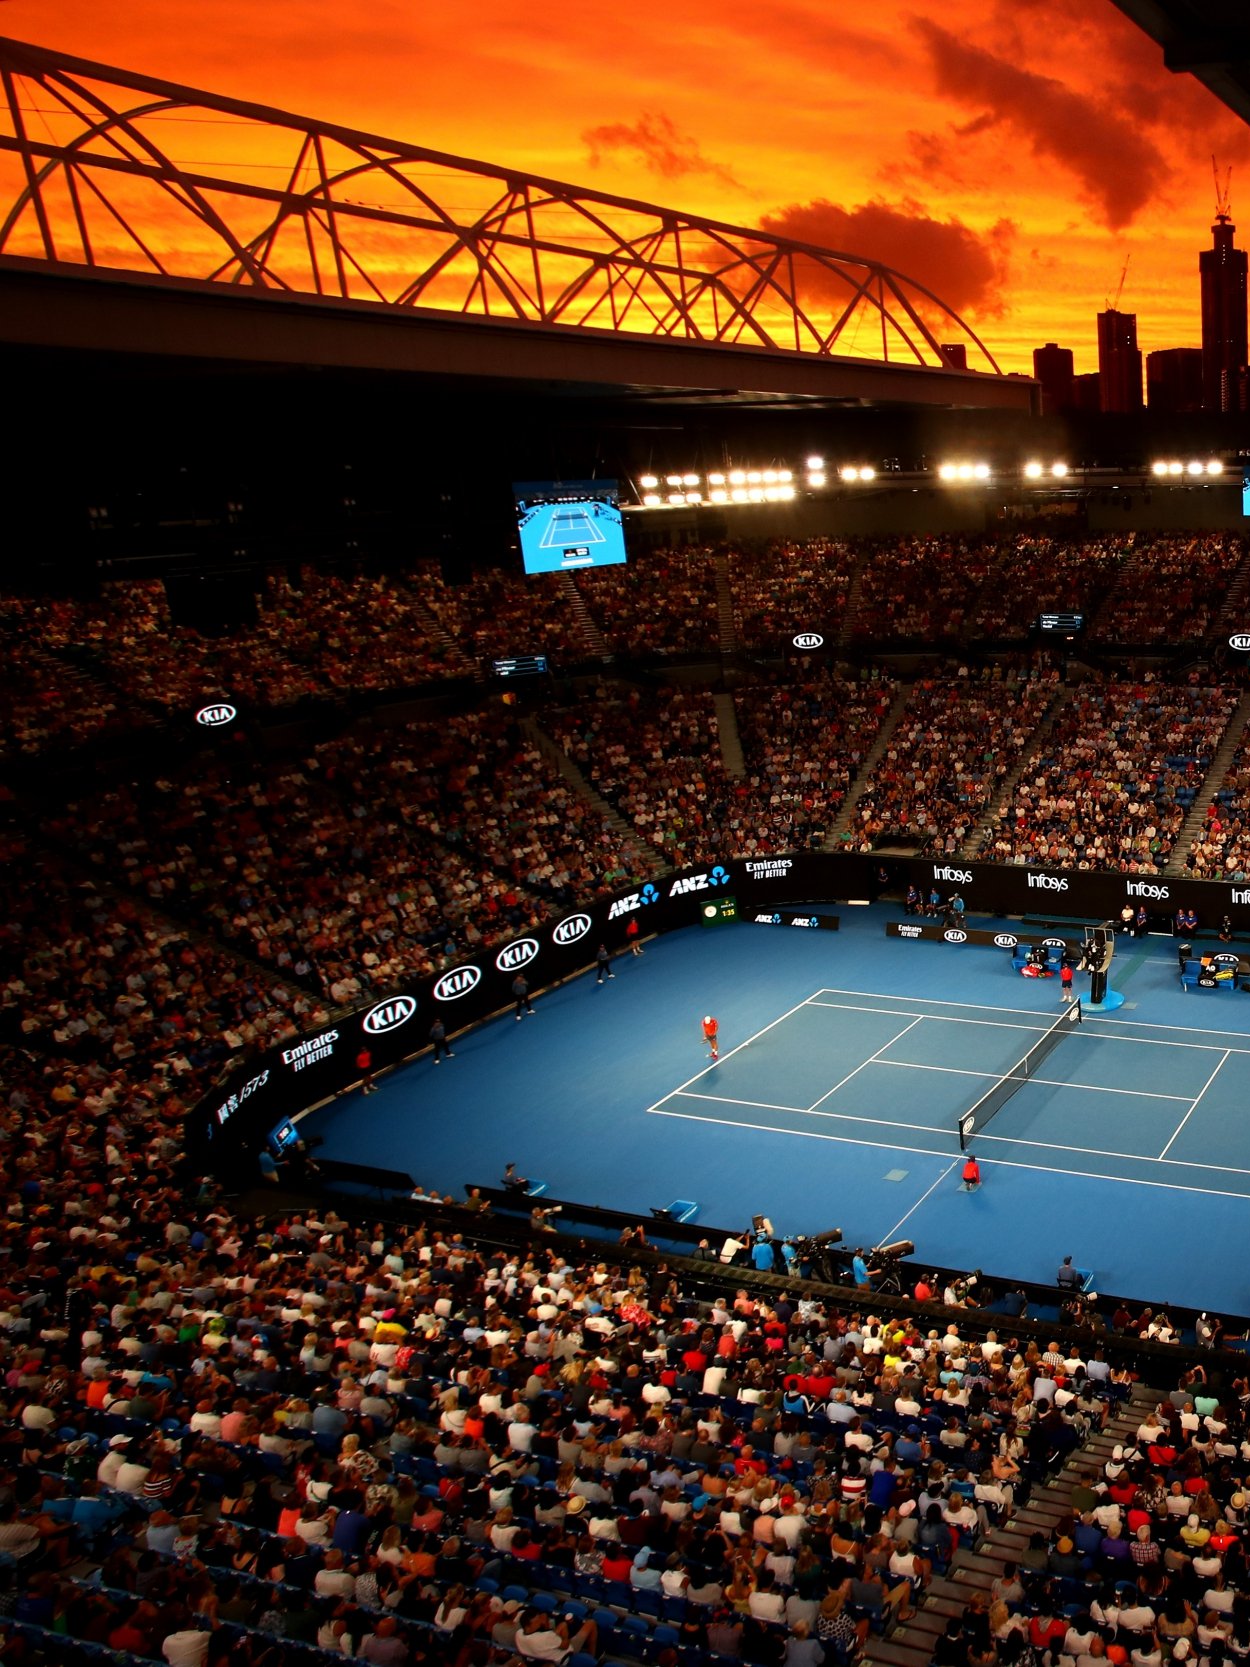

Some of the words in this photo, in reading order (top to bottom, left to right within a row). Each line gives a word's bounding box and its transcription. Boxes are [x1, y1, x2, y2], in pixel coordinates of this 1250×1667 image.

[798, 636, 819, 646] KIA
[203, 708, 231, 723] KIA
[745, 858, 792, 872] Emirates
[753, 871, 765, 880] FLY
[766, 868, 787, 878] BETTER
[933, 865, 973, 884] Infosys
[669, 873, 709, 897] ANZ
[1027, 872, 1069, 892] Infosys
[1126, 880, 1169, 900] Infosys
[608, 893, 641, 920] ANZ
[754, 914, 773, 924] ANZ
[791, 918, 810, 927] ANZ
[559, 919, 586, 942] KIA
[948, 931, 963, 941] KIA
[998, 936, 1014, 944] KIA
[502, 943, 533, 968] KIA
[441, 971, 474, 997] KIA
[371, 1001, 408, 1029] KIA
[282, 1029, 339, 1065] Emirates
[293, 1057, 307, 1072] FLY
[306, 1044, 333, 1067] BETTER
[239, 1069, 270, 1103] 1573
